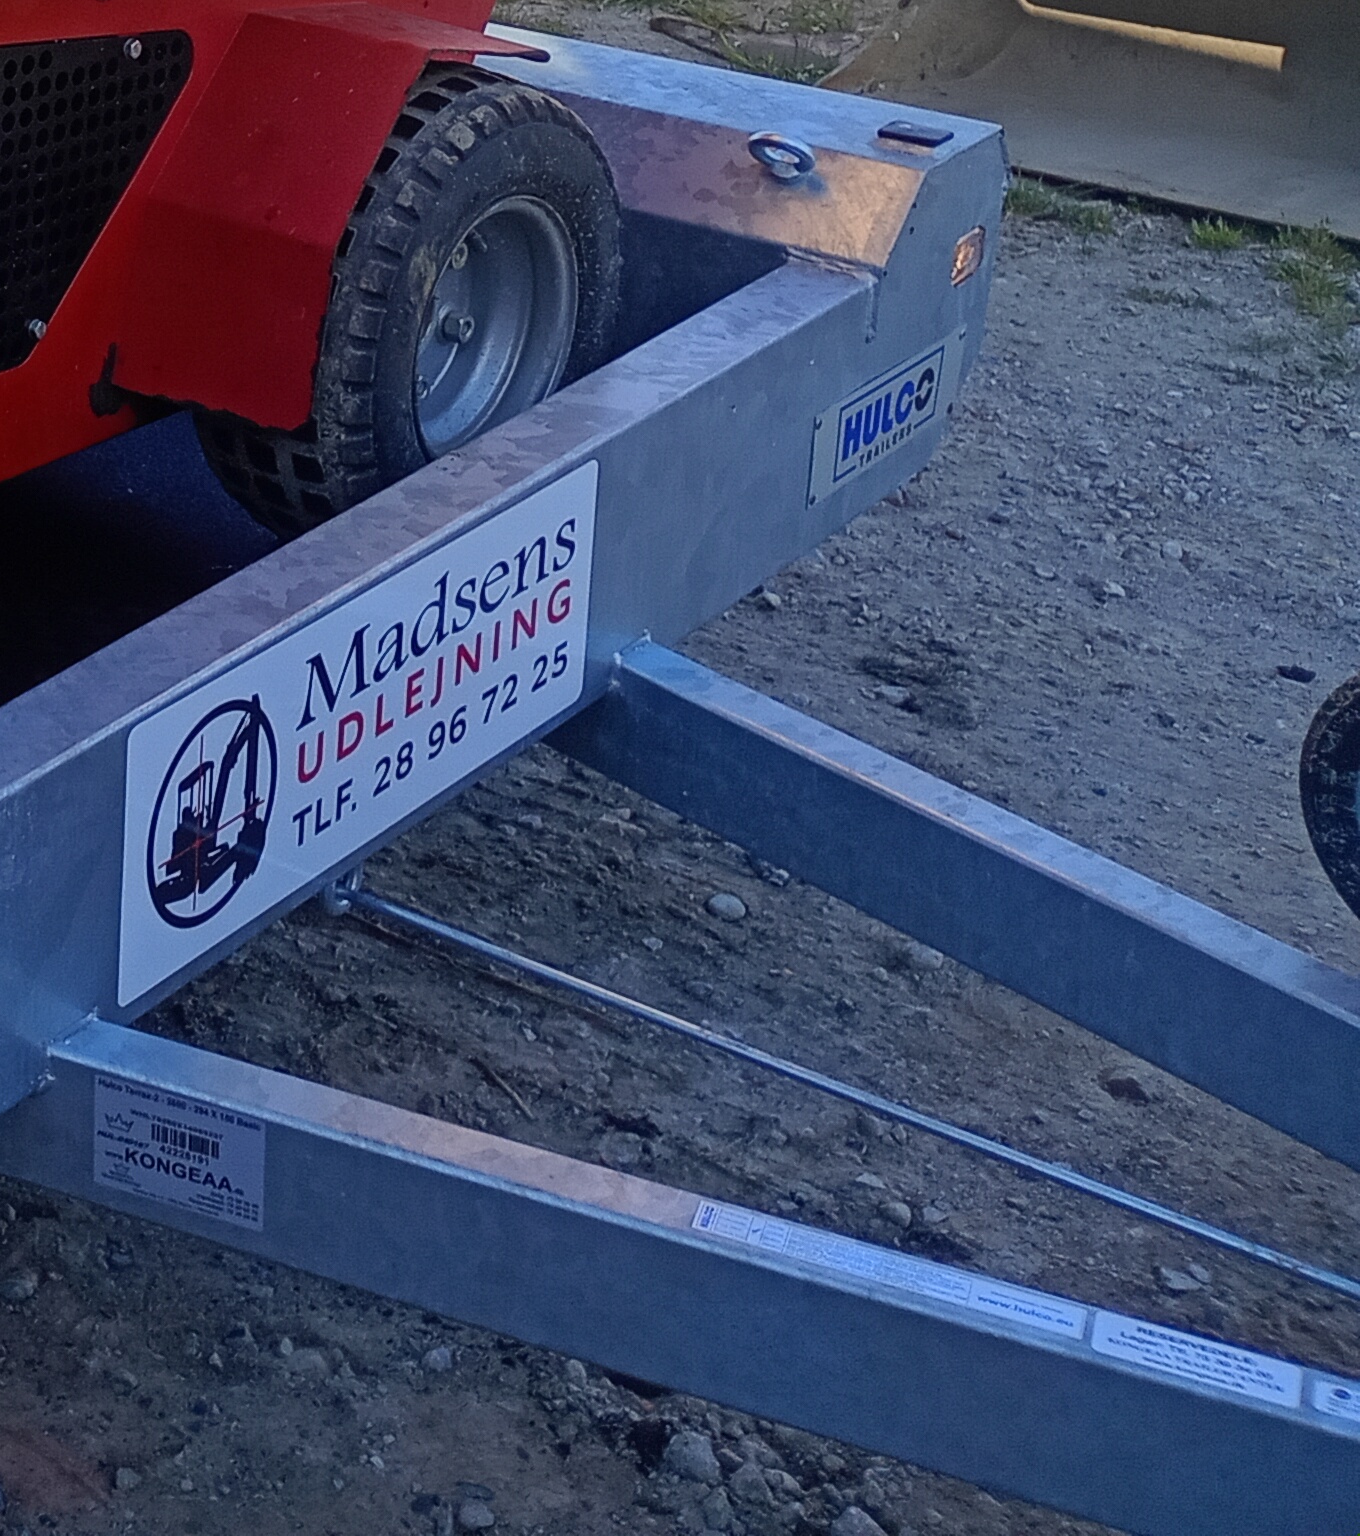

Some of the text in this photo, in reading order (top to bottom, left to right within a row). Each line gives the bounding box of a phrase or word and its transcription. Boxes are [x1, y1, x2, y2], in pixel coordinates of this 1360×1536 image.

[841, 367, 935, 462] HULCO
[859, 423, 912, 467] TRAILERS
[296, 518, 576, 732] Madsens
[297, 579, 571, 784] UDLEJNING
[293, 641, 568, 847] TLF. 28 96 72 25
